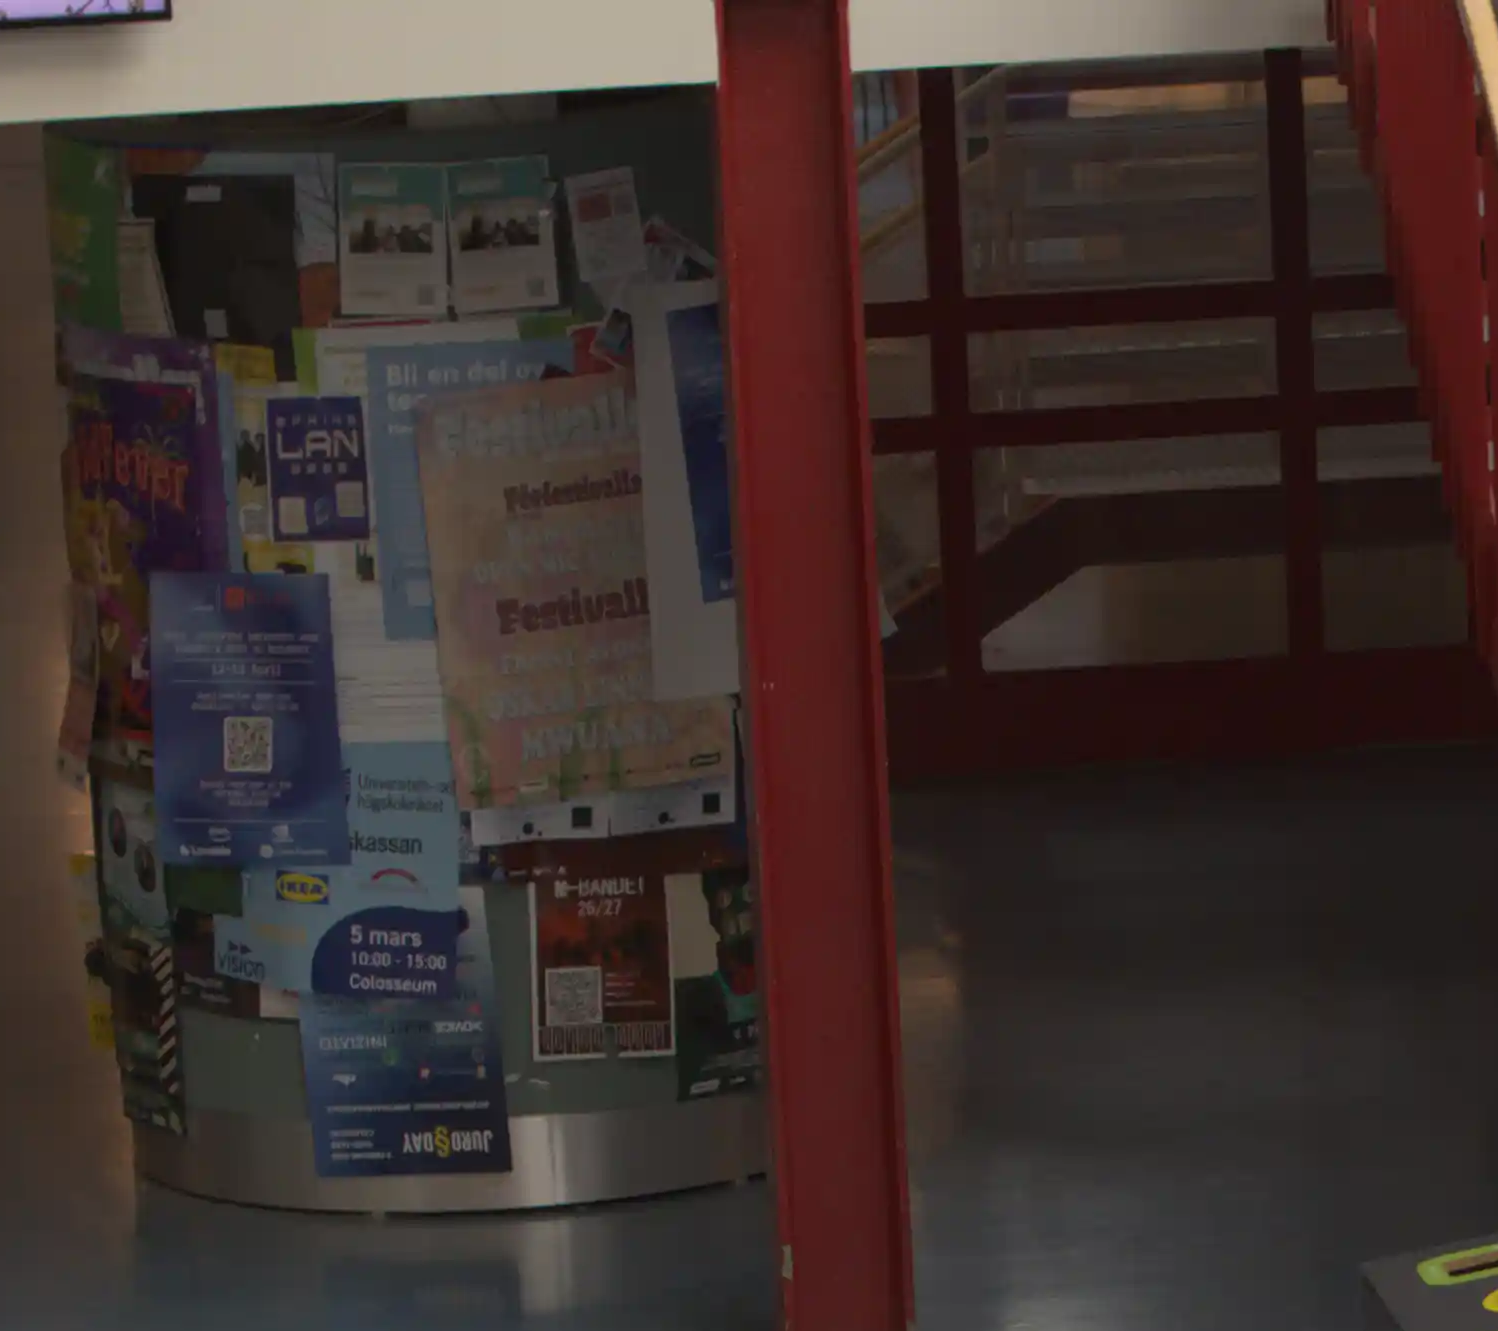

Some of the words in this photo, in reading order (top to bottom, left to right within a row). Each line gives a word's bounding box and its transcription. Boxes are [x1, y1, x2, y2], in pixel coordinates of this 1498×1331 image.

[386, 361, 419, 388] Bli
[427, 364, 461, 386] en
[467, 358, 508, 383] del
[274, 429, 359, 460] LAN
[350, 925, 363, 943] 5
[369, 929, 422, 948] mars
[351, 951, 391, 968] 10:00
[406, 953, 447, 970] 15:00
[349, 974, 438, 994] Colosseum
